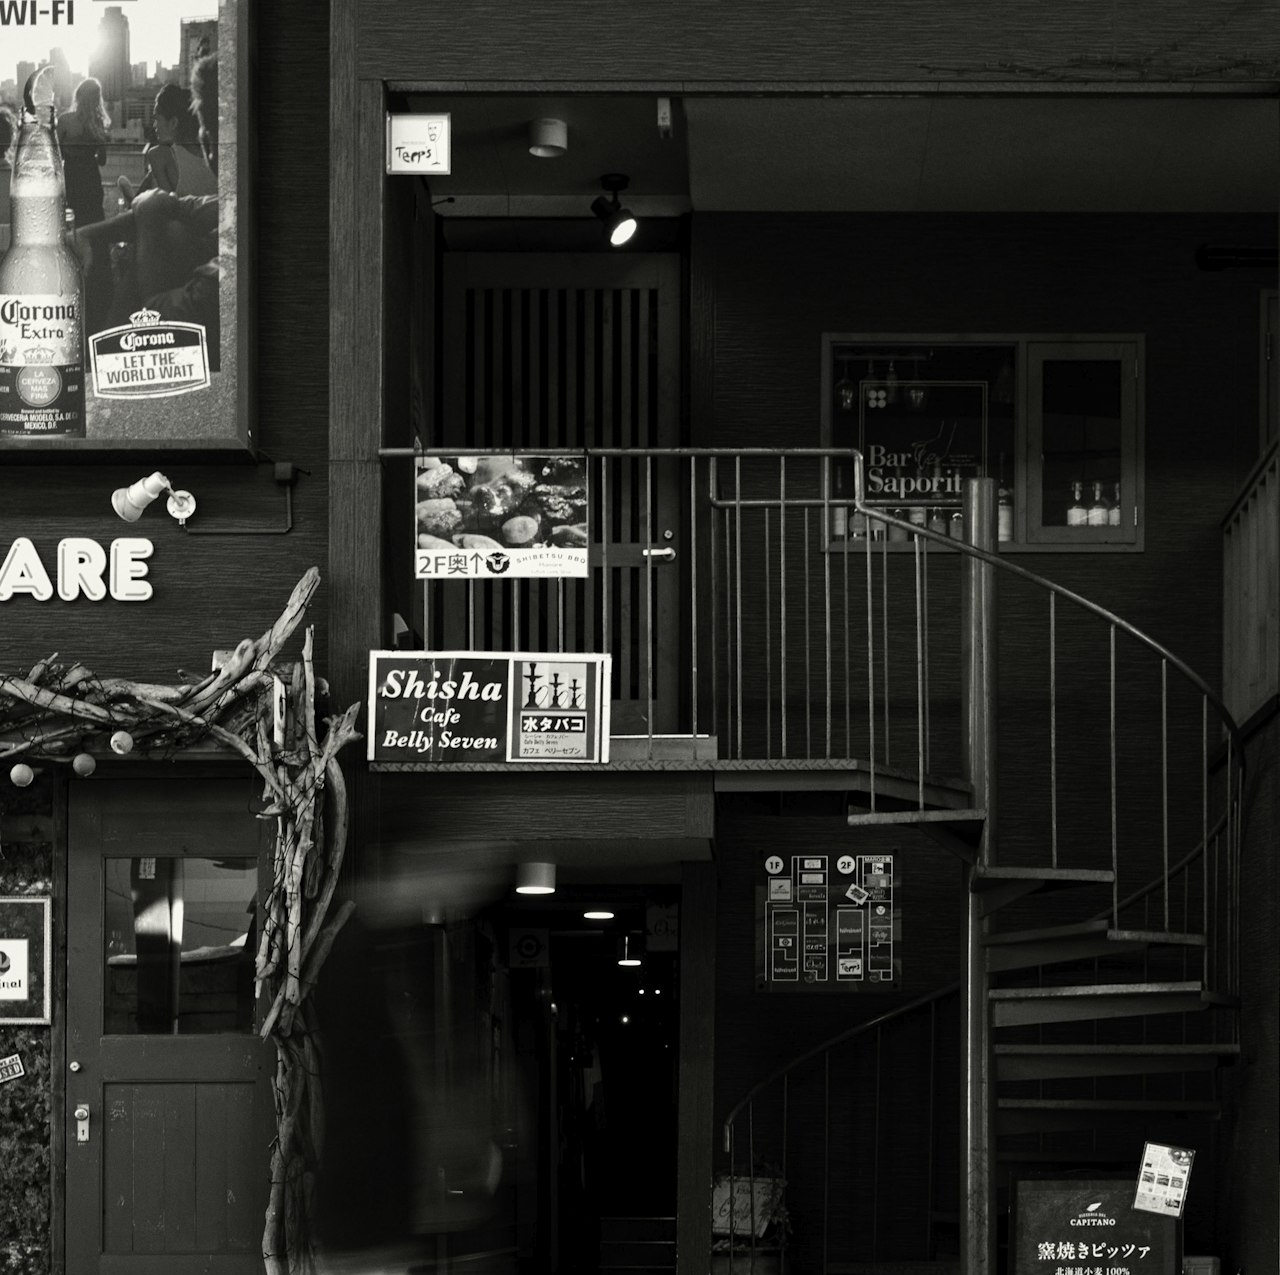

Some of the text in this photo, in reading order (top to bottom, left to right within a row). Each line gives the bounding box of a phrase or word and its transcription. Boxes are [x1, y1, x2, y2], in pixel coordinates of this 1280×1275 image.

[0, 299, 76, 328] Corona
[21, 323, 65, 340] Extra
[120, 331, 175, 351] Corona
[123, 352, 176, 369] LET THE
[106, 364, 195, 385] WORLD WAIT
[868, 444, 912, 467] Bar
[868, 468, 964, 499] Saporit
[516, 553, 586, 564] SHIBETSU BBQ
[381, 668, 503, 702] Shisha
[420, 707, 461, 728] Cafe
[523, 716, 585, 733] 水タバコ
[382, 730, 498, 753] Belly Seven
[523, 747, 540, 755] カフェ
[770, 861, 780, 870] 1F
[840, 861, 852, 870] 2F
[1070, 1218, 1116, 1226] CAPITANO
[1038, 1242, 1151, 1262] 窯焼きピッツァ
